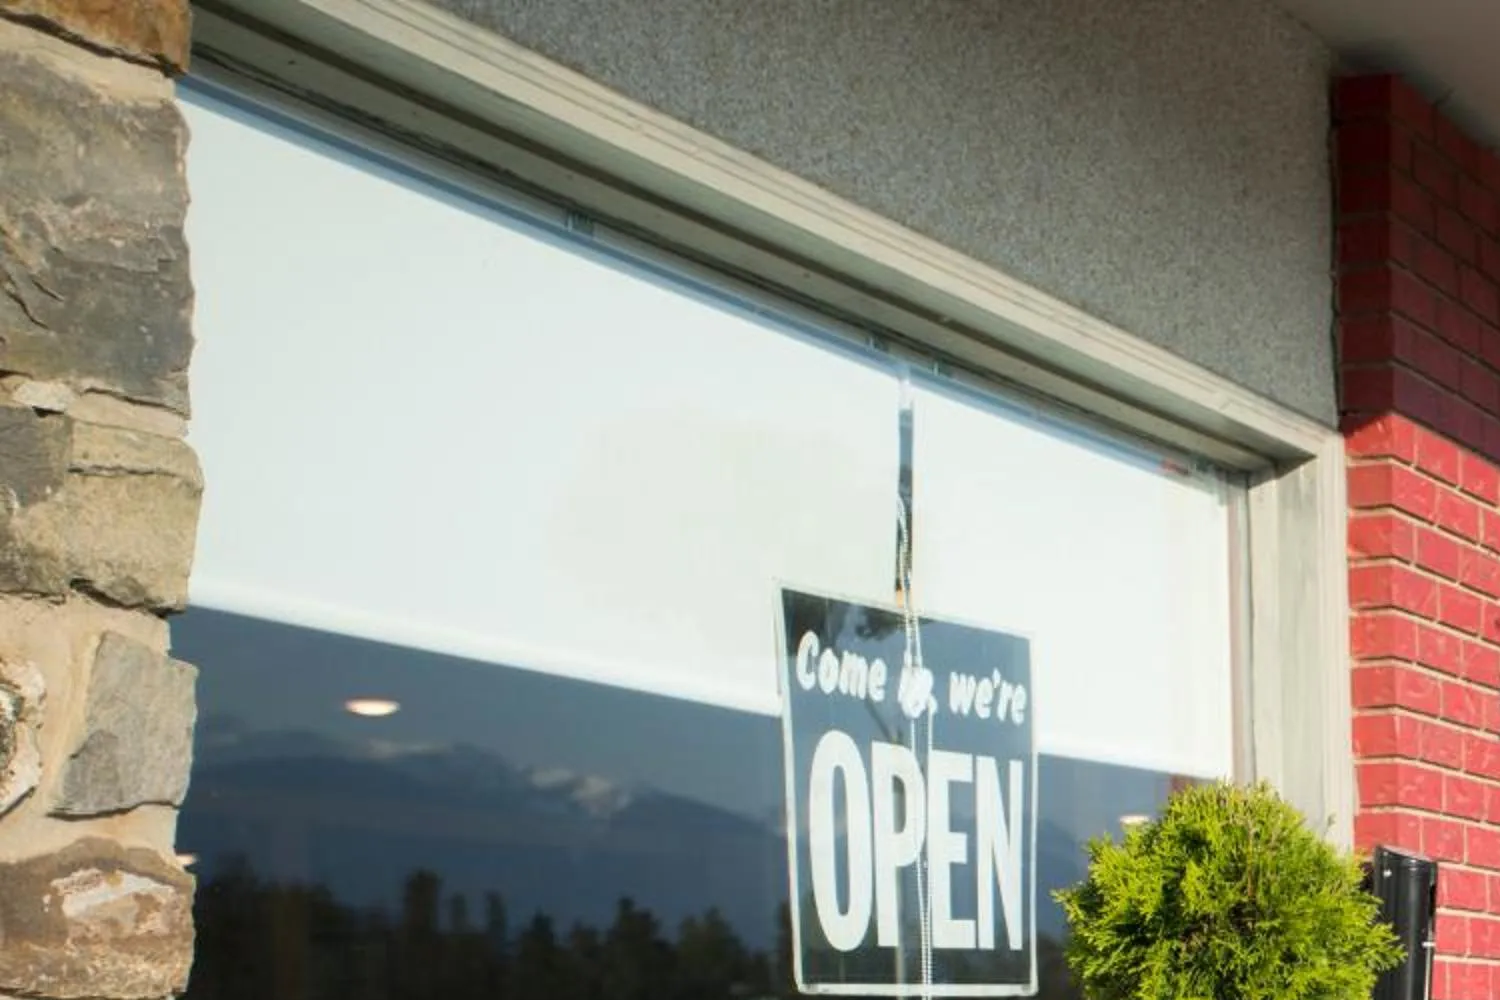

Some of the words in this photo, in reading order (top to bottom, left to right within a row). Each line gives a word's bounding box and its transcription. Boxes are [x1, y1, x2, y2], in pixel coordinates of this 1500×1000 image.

[796, 630, 888, 703] Come
[949, 667, 1028, 727] we're
[808, 729, 1024, 953] OPEN
